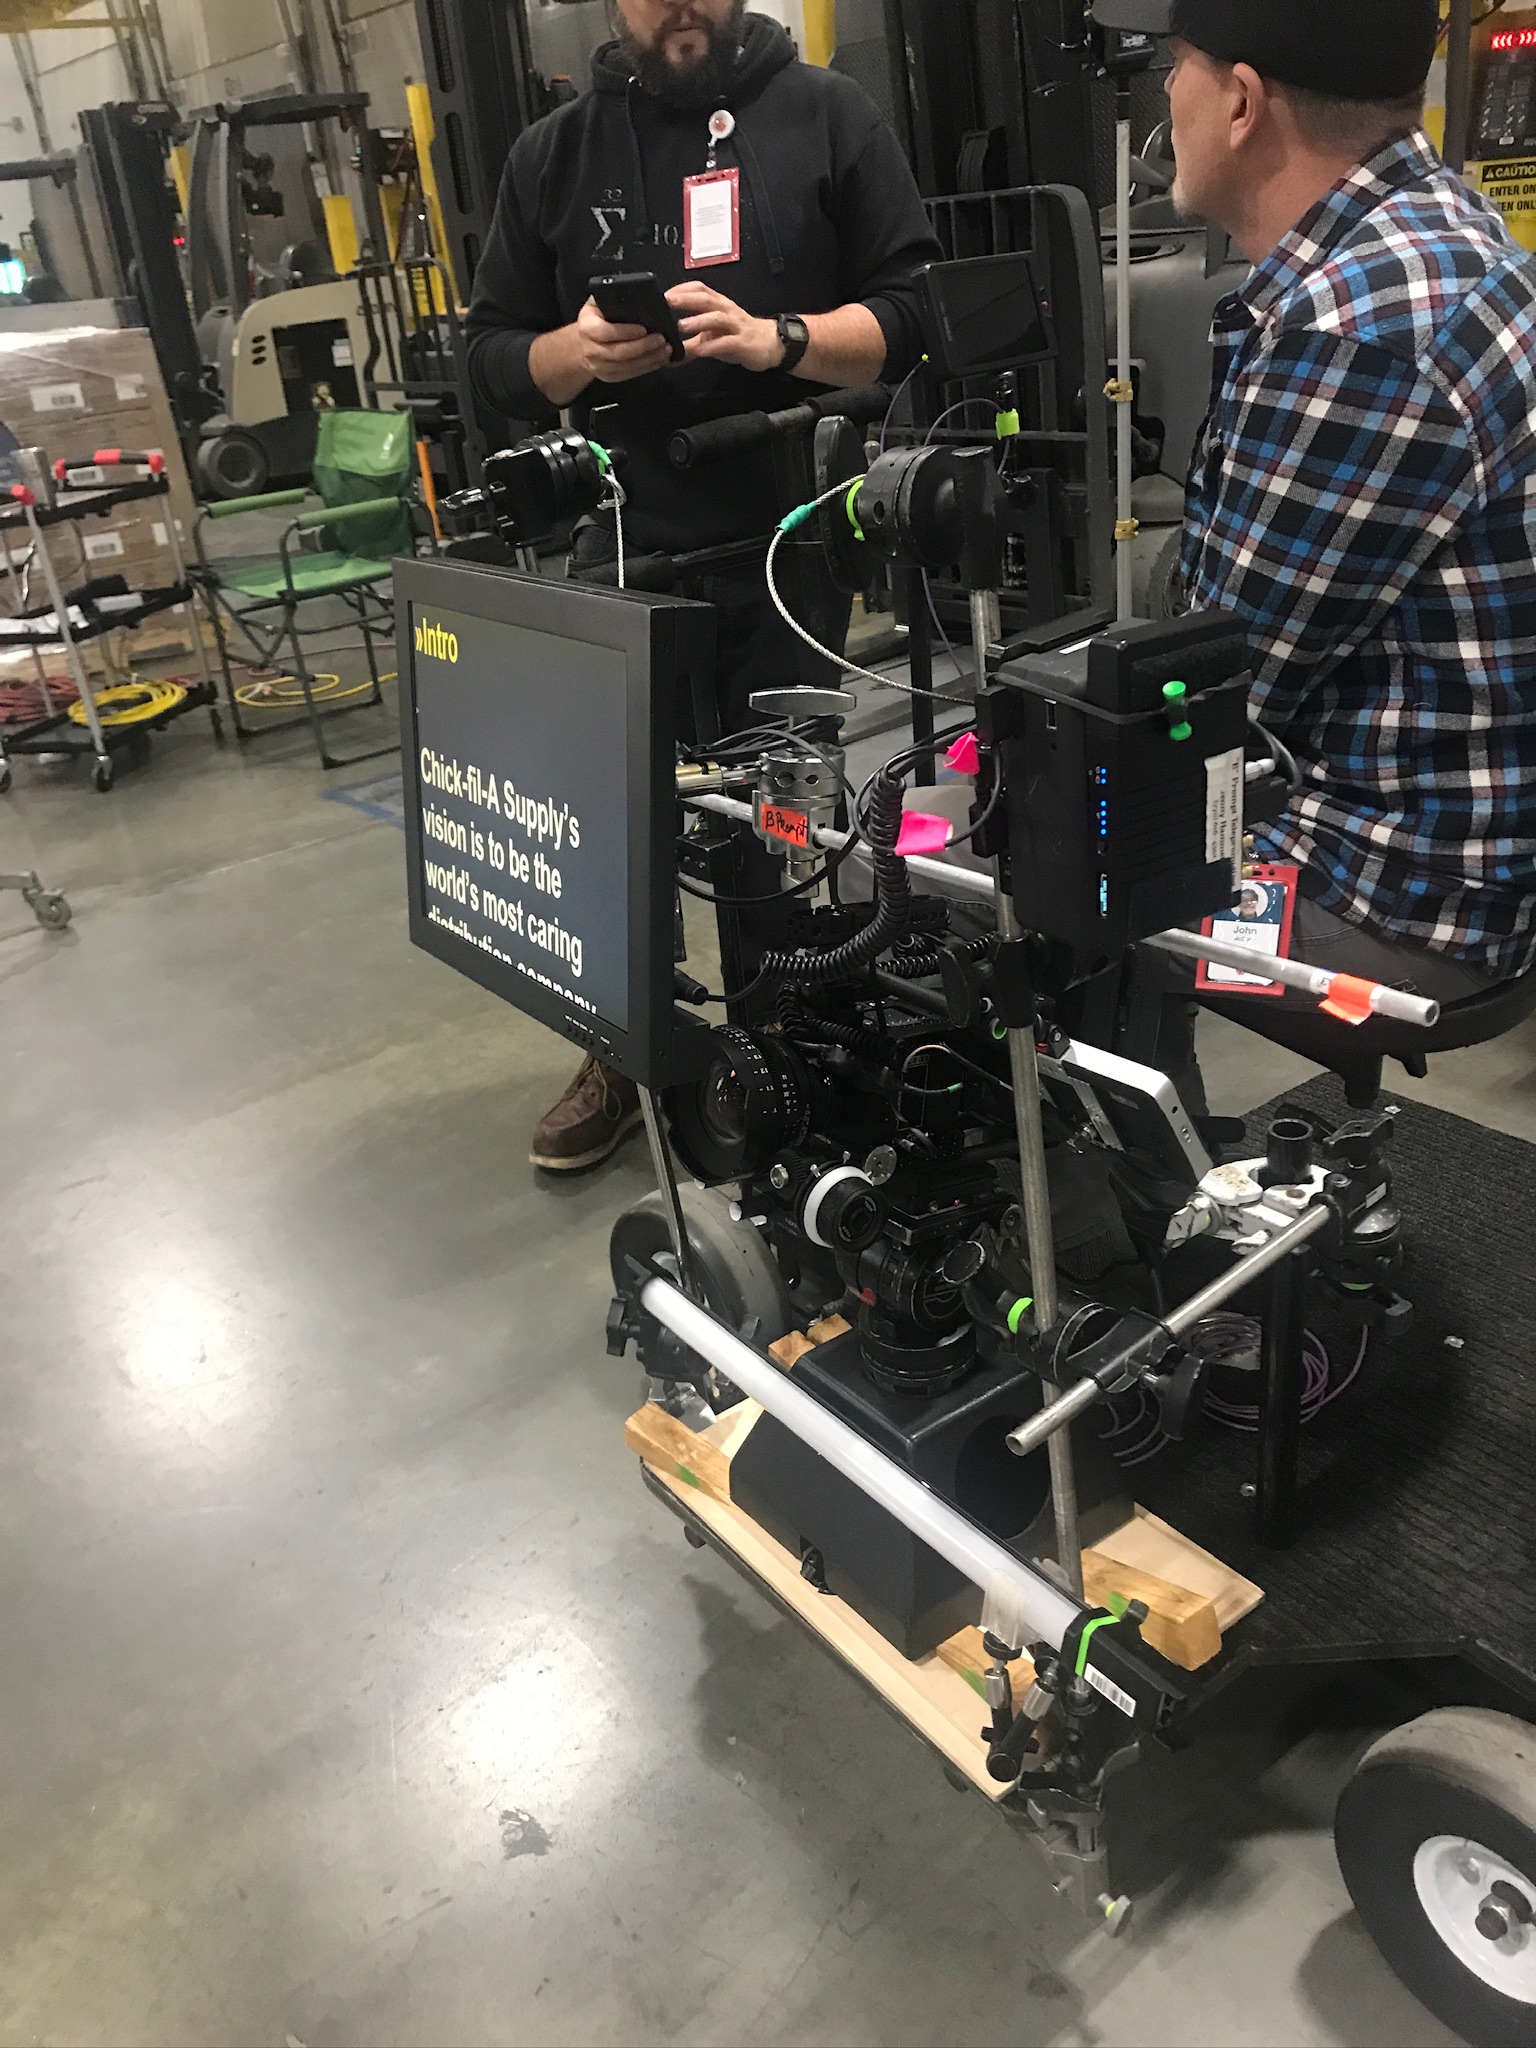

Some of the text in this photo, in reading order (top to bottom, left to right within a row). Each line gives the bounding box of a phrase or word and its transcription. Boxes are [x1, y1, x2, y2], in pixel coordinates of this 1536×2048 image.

[1489, 184, 1519, 197] ENTER
[1517, 199, 1536, 211] ONL
[420, 746, 581, 851] Chick-fil-A Supply's
[422, 802, 562, 899] vision is to be the
[424, 859, 583, 978] world's most caring
[1232, 925, 1257, 935] John
